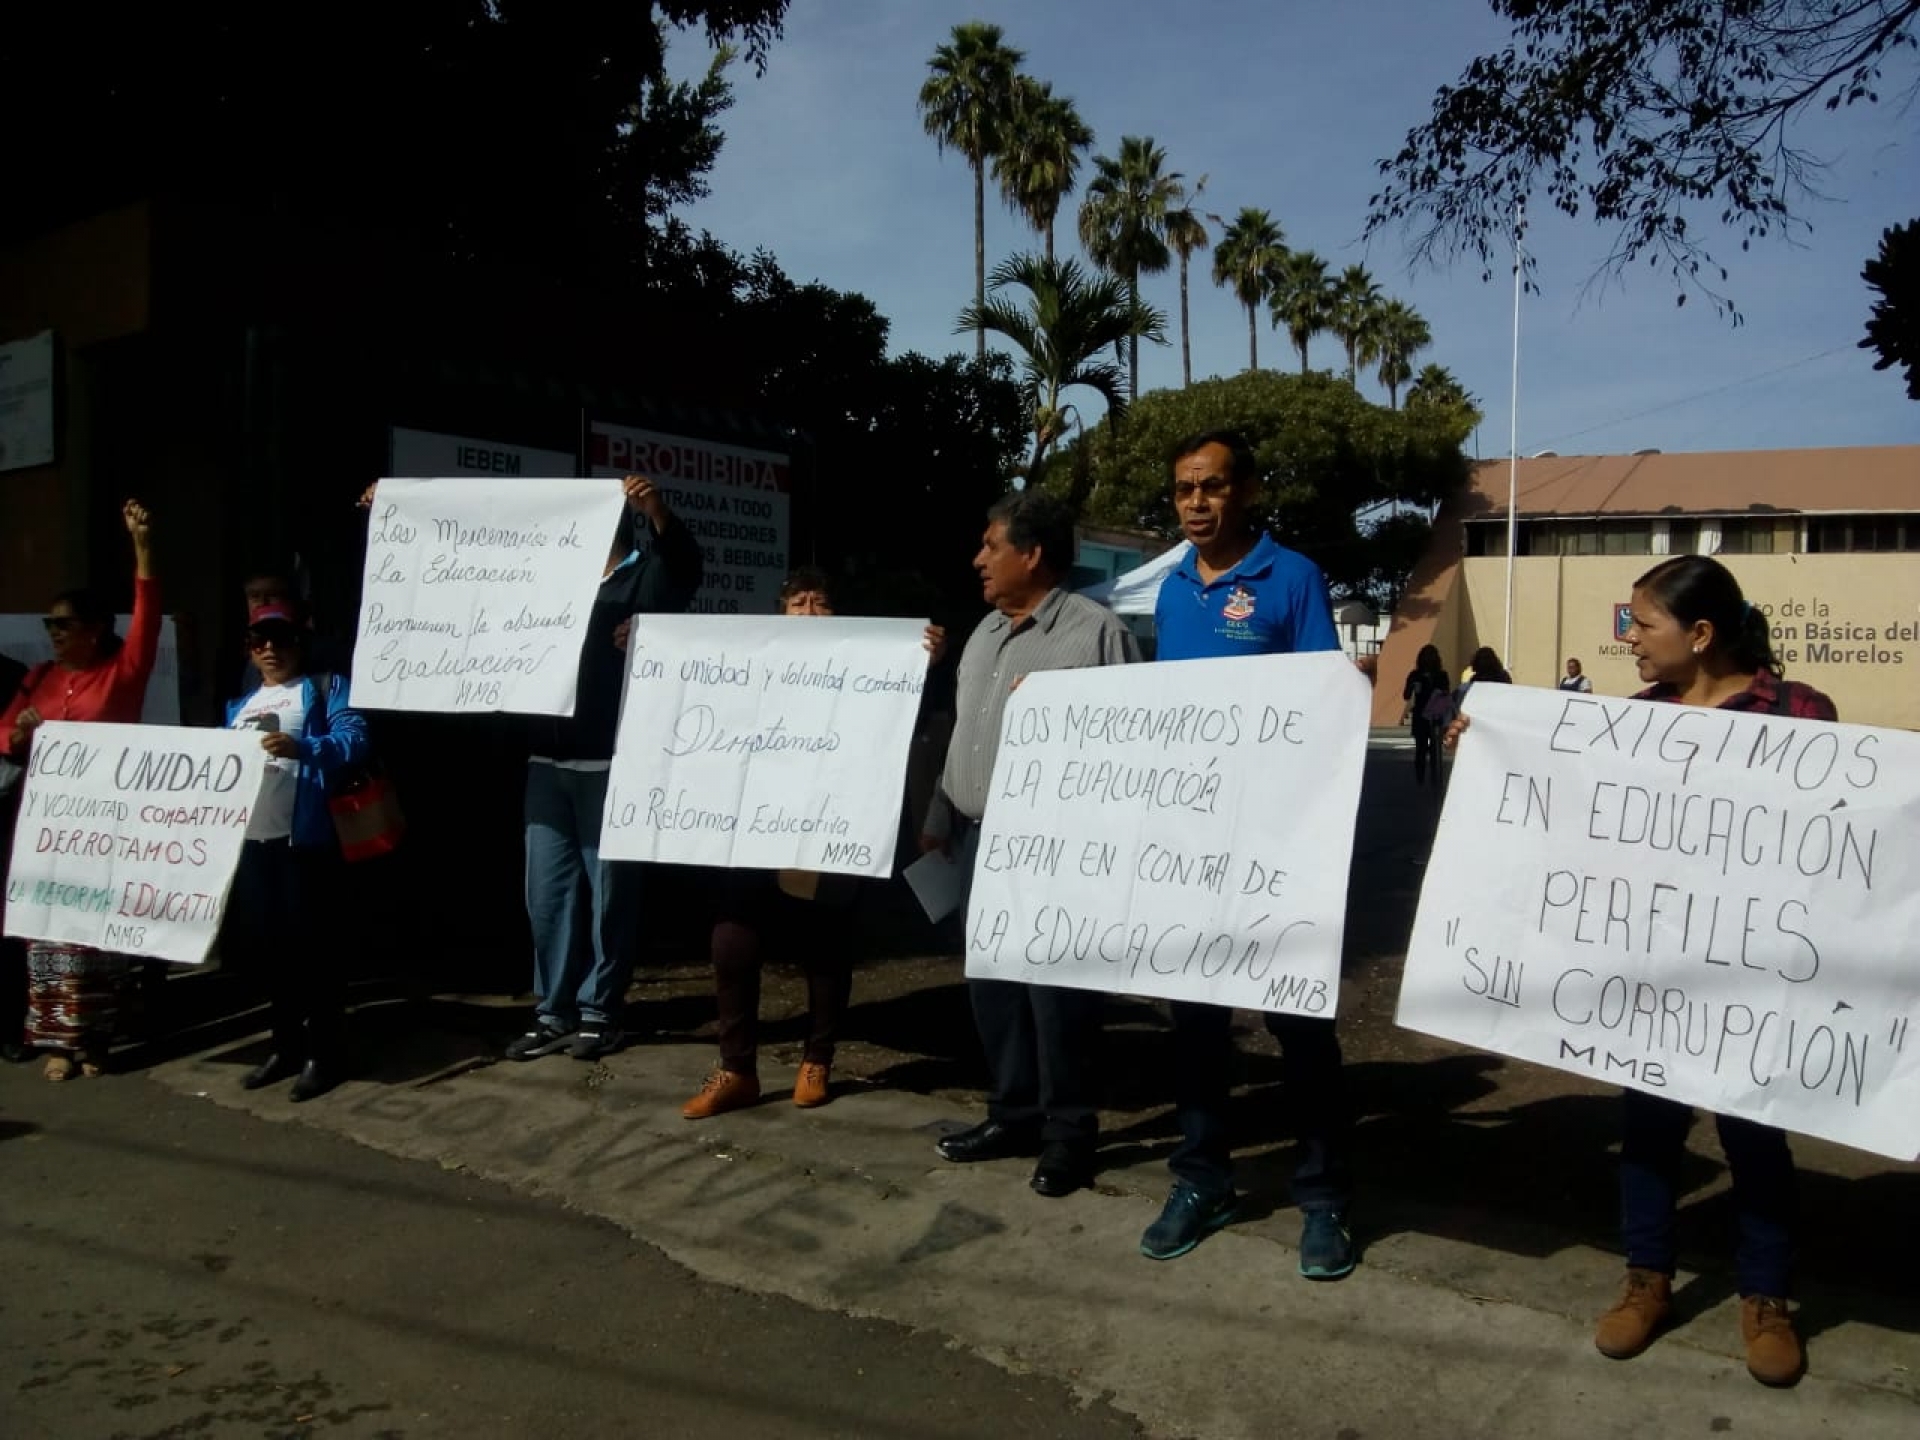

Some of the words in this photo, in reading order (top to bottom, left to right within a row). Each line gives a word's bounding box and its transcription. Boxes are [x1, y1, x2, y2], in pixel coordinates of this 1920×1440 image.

[457, 446, 521, 475] IEBEM
[609, 435, 778, 492] PROHIBIDA
[372, 503, 417, 544] Los
[558, 521, 584, 549] de
[719, 497, 729, 513] A
[730, 498, 773, 518] TODO
[369, 552, 407, 584] La
[723, 548, 785, 569] BEBIDAS
[735, 574, 755, 593] DE
[1780, 597, 1806, 618] de
[1812, 597, 1830, 618] la
[1804, 620, 1877, 641] Básica
[1884, 620, 1920, 642] del
[371, 639, 557, 684] Evaluación
[630, 645, 664, 680] Con
[1774, 642, 1798, 663] de
[1805, 642, 1904, 665] Morelos
[455, 680, 503, 707] MMB
[663, 704, 841, 757] Derrotamos
[1004, 704, 1050, 748] LOS
[1062, 703, 1241, 751] MERCENARIOS
[1257, 707, 1306, 746] DE
[1548, 697, 1881, 791] EXIGIMOS
[114, 746, 243, 793] UNIDAD
[1001, 759, 1043, 809] LA
[26, 791, 39, 818] Y
[42, 792, 129, 822] VOLUNTAD
[140, 804, 250, 829] COMBATIVA
[607, 786, 637, 829] La
[646, 786, 739, 833] Reforma
[750, 793, 850, 835] Educativa
[36, 827, 208, 867] DERROTAMOS
[1495, 771, 1552, 833] EN
[1588, 779, 1878, 891] EDUCACIÓN
[821, 841, 873, 867] MMB
[983, 833, 1067, 878] ESTAN
[1078, 841, 1117, 878] EN
[1239, 859, 1288, 898] DE
[104, 922, 148, 949] MMB
[969, 906, 1010, 963] LA
[1024, 905, 1316, 982] EDUCACIÓN
[1538, 869, 1821, 984] PERFILES
[1261, 973, 1328, 1014] MMB
[1559, 1037, 1668, 1088] MMB
